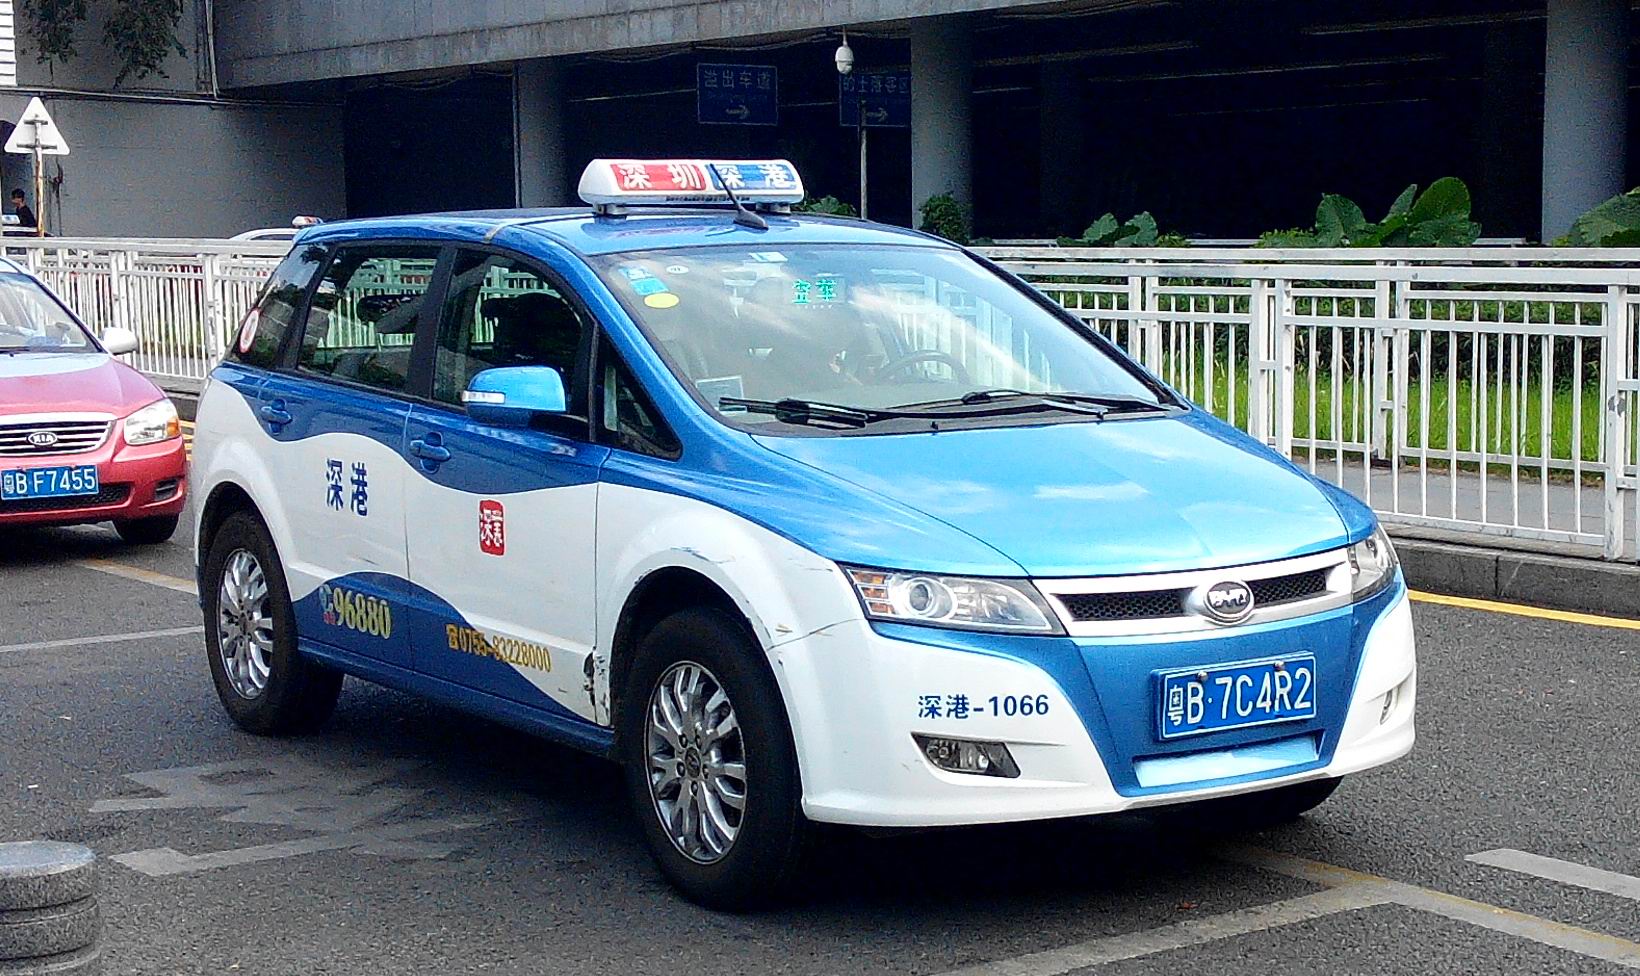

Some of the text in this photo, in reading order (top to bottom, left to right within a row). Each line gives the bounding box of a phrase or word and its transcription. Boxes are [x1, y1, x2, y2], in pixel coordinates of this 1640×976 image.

[620, 164, 791, 188] 深圳 深港
[34, 433, 54, 444] KIA
[326, 459, 368, 516] 深港
[333, 587, 392, 639] 96880
[918, 694, 1049, 719] 深港-1066
